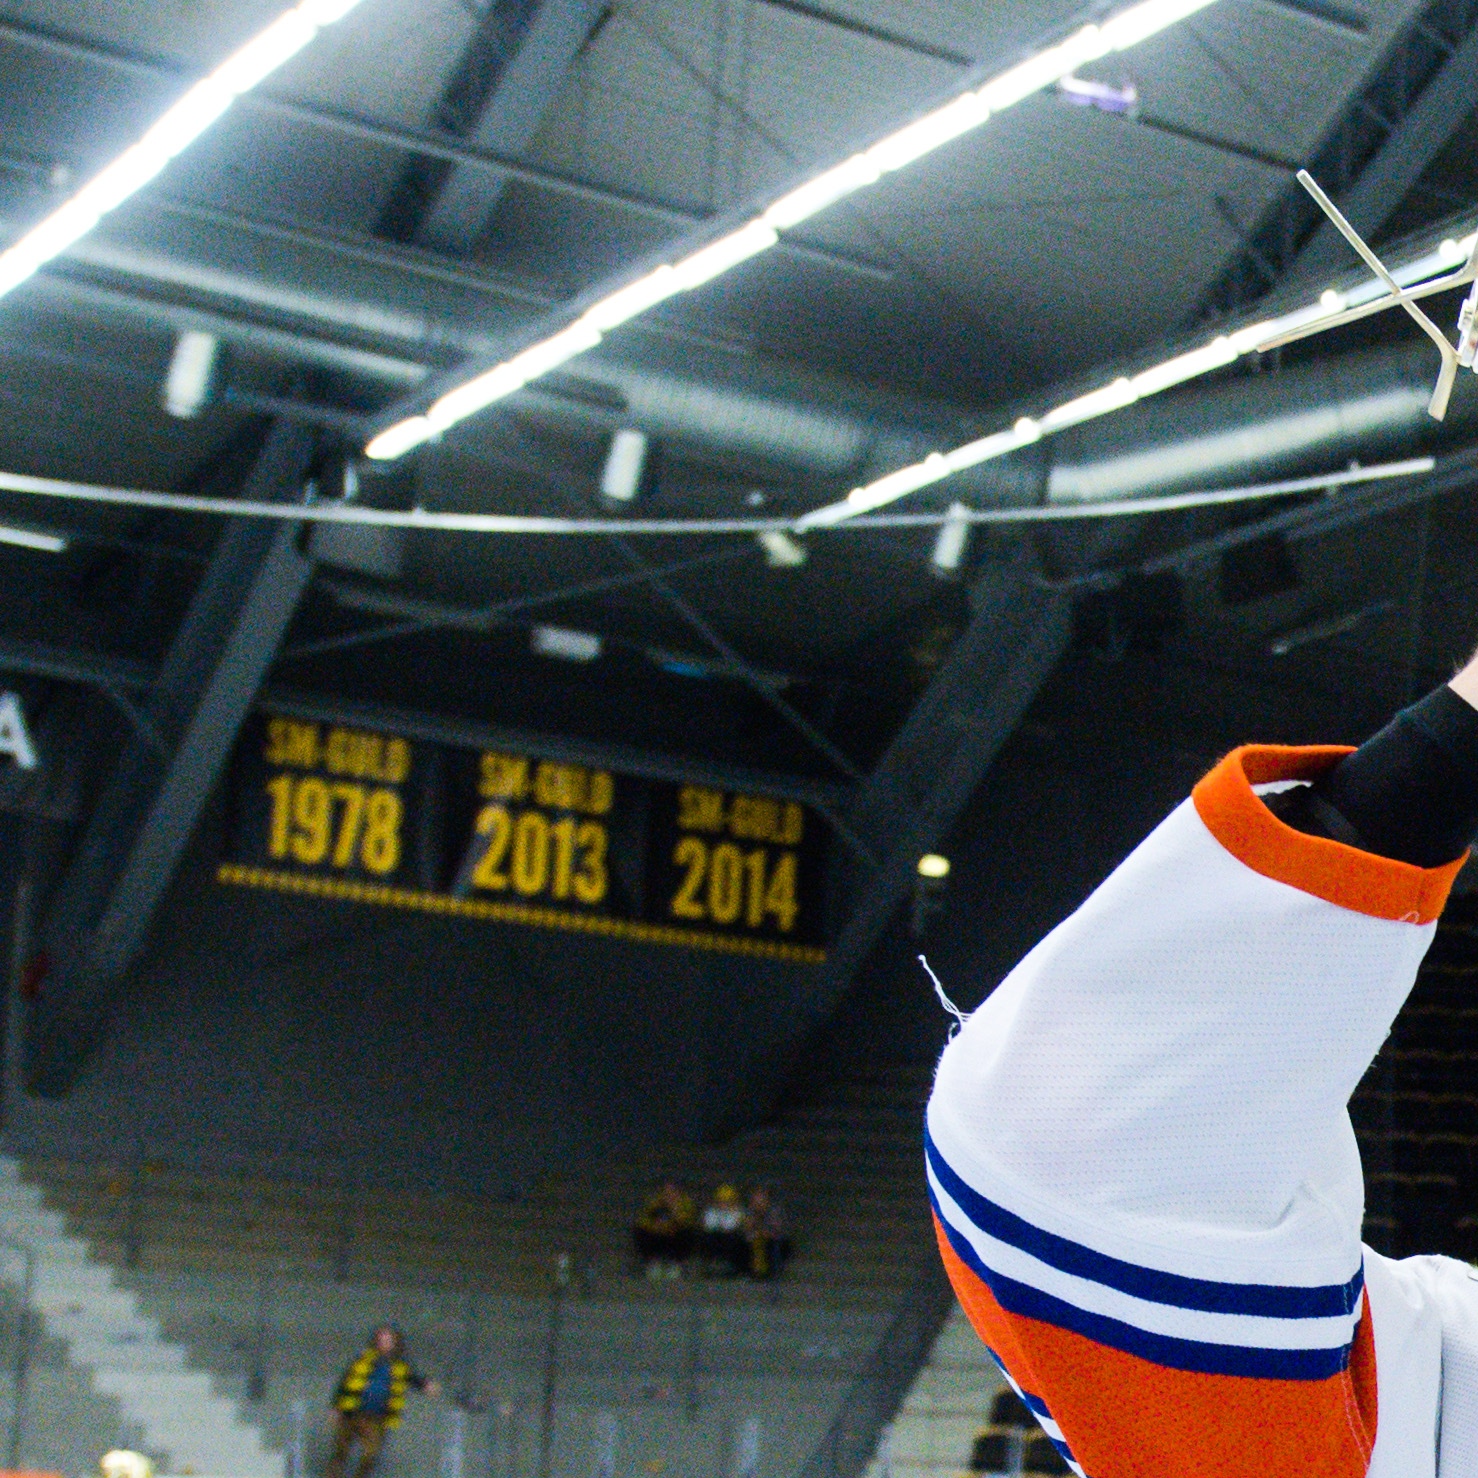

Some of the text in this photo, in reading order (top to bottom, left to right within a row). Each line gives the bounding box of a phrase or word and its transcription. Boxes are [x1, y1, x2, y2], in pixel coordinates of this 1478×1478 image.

[267, 776, 402, 876] 1978
[472, 803, 609, 904] 2013
[670, 836, 799, 933] 2014
